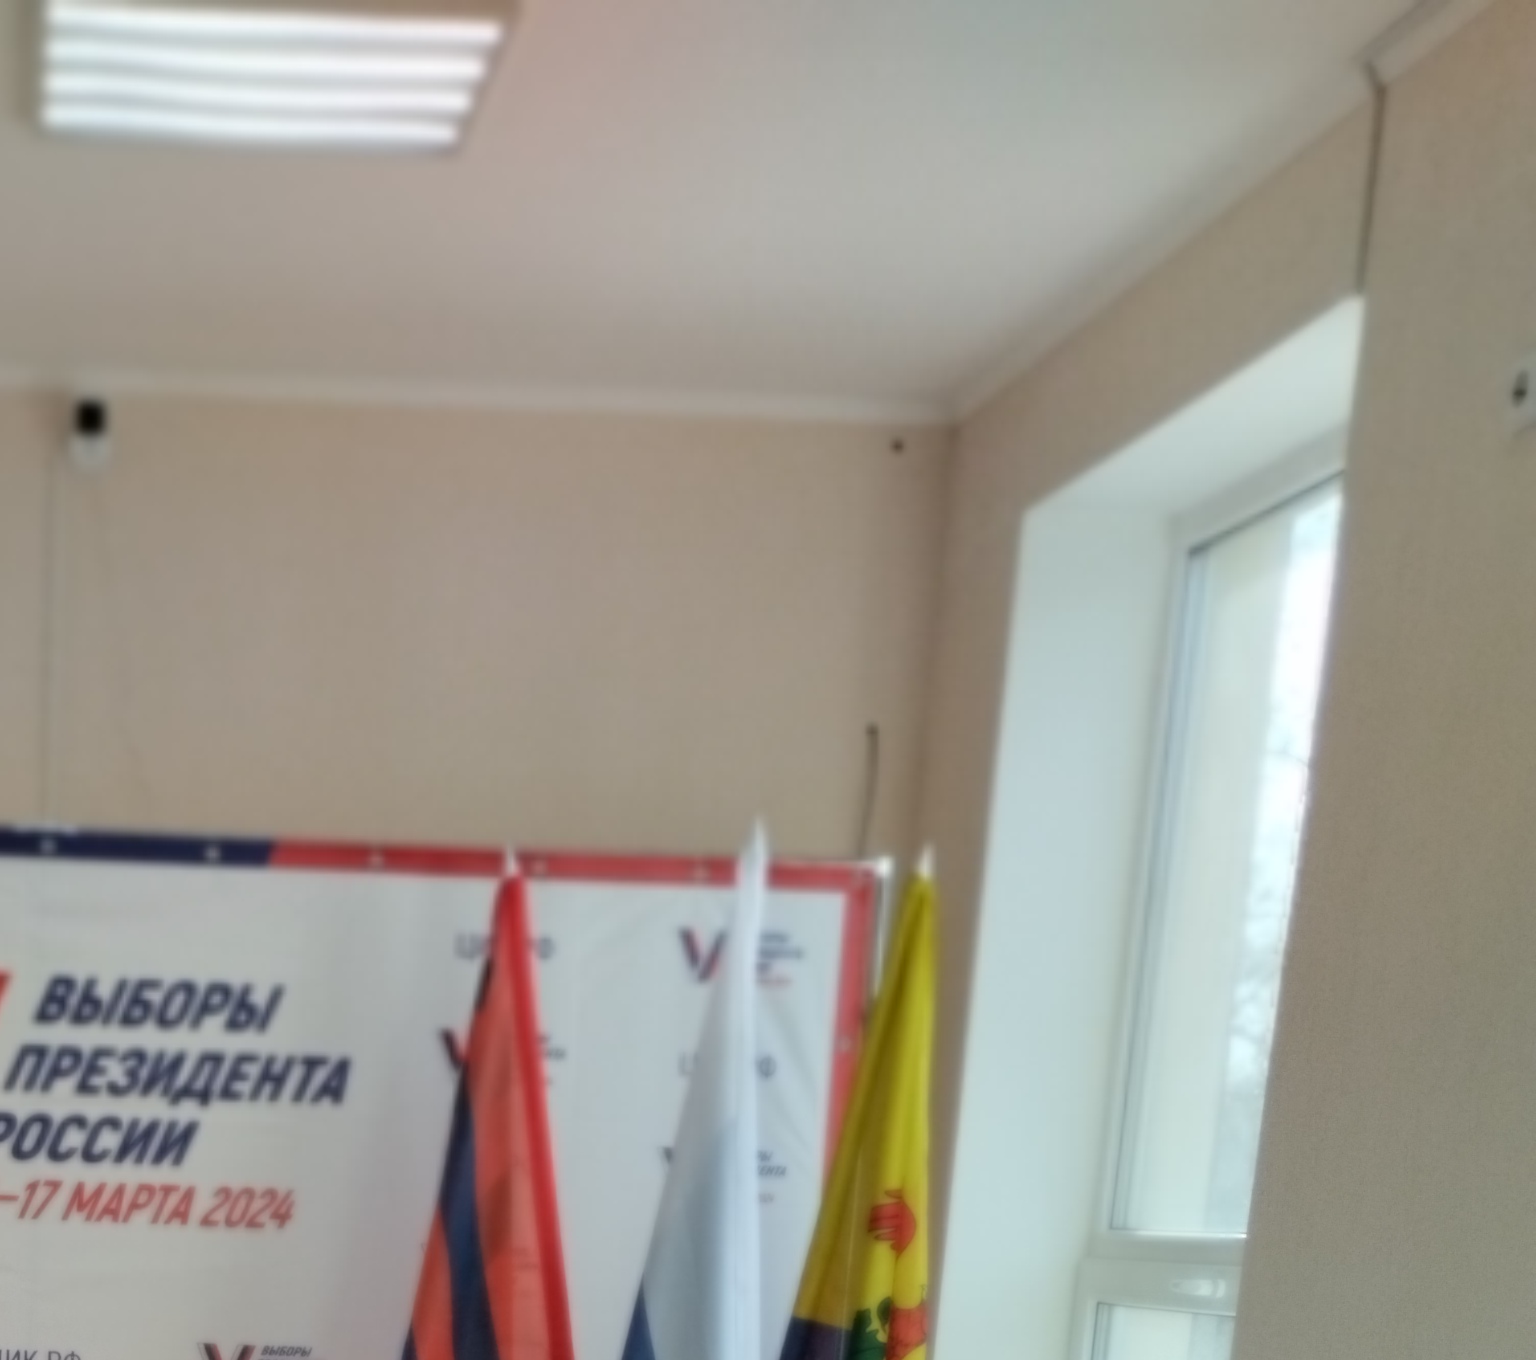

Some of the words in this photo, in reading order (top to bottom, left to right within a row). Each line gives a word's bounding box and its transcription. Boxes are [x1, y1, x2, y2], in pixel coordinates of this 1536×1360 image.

[33, 974, 286, 1035] ВЫБОРЫ
[3, 1043, 353, 1106] ПРЕЗИДЕНТА
[61, 1178, 197, 1227] МАРТА
[198, 1185, 296, 1231] 2024
